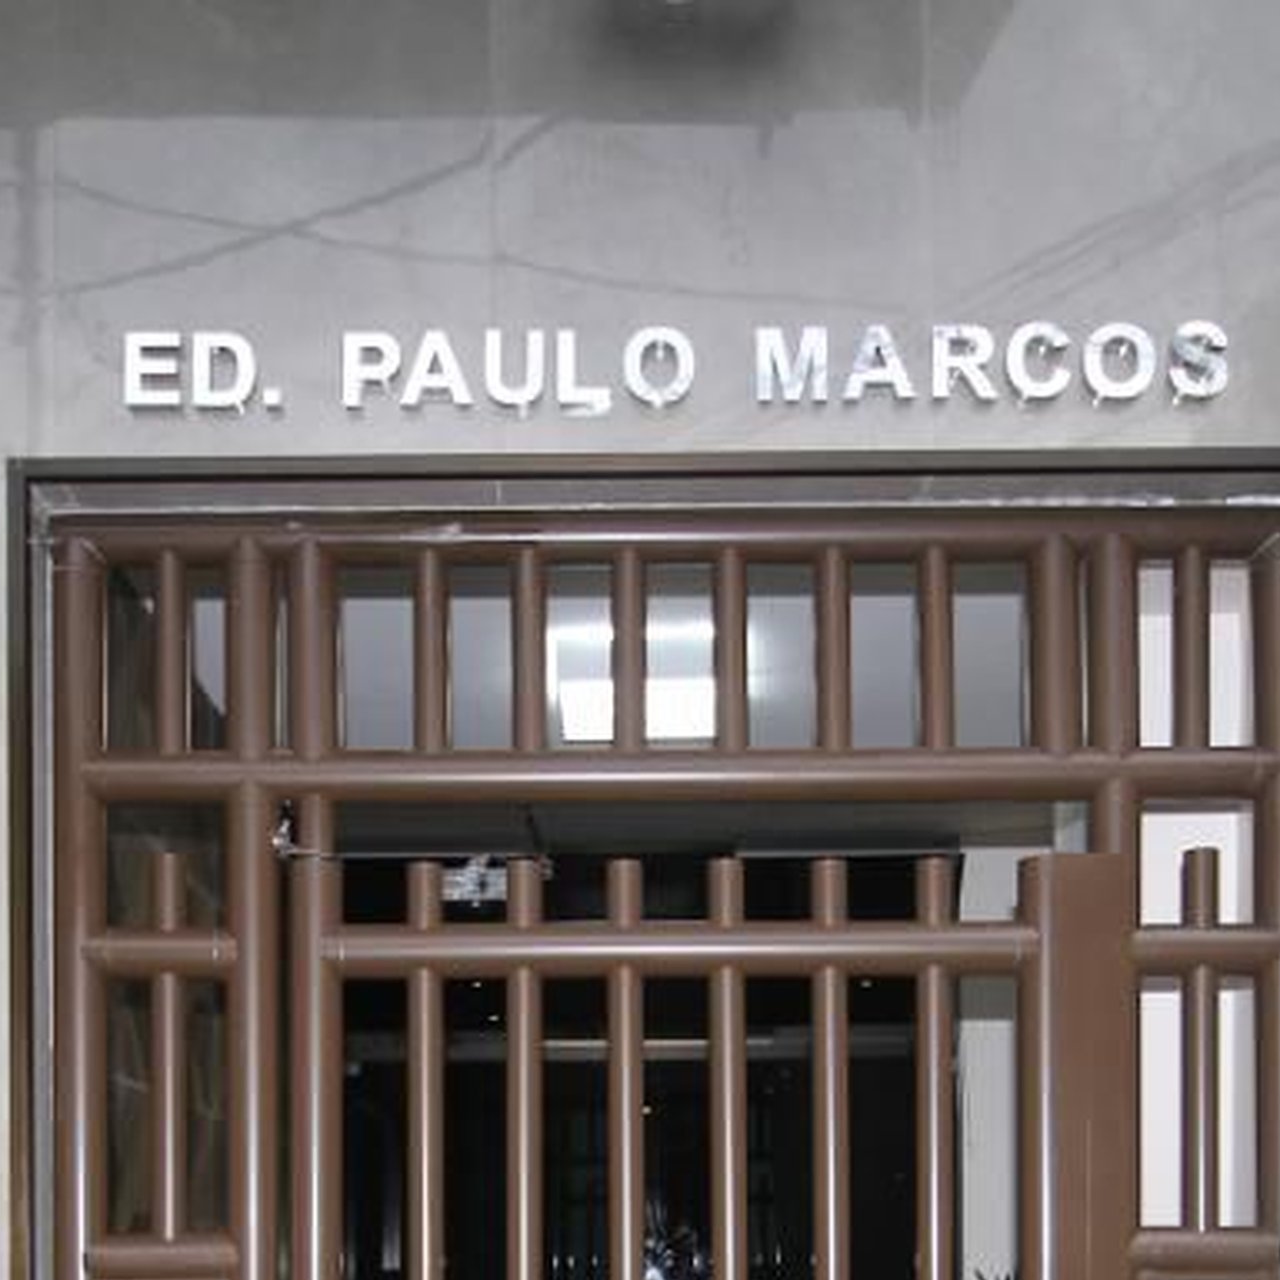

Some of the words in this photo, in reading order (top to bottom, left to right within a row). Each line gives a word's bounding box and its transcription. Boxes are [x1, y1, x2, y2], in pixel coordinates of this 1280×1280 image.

[123, 330, 282, 408] ED.
[342, 326, 696, 411] PAULO
[753, 319, 1230, 404] MARCOS
